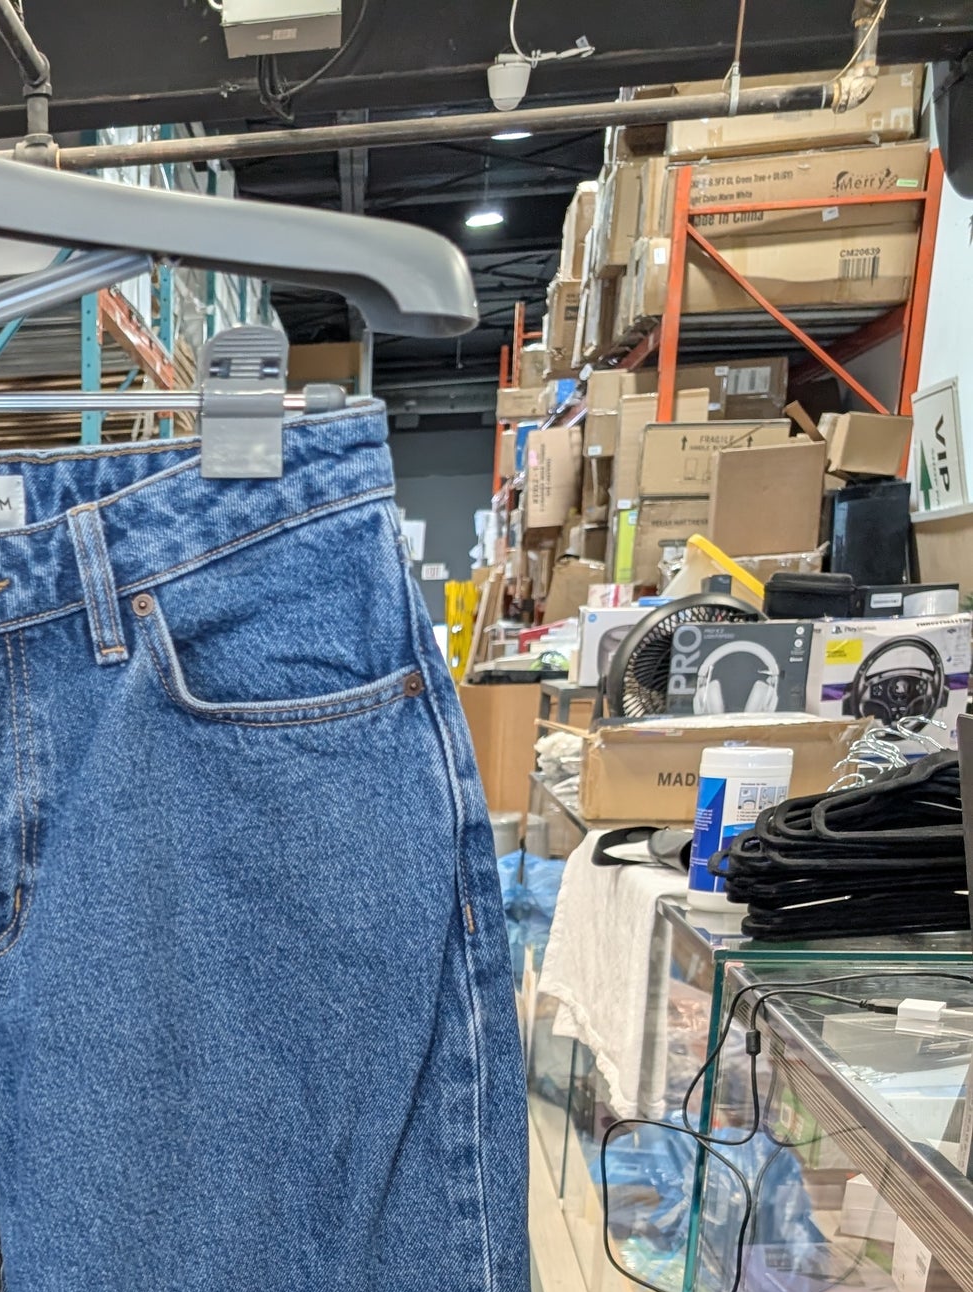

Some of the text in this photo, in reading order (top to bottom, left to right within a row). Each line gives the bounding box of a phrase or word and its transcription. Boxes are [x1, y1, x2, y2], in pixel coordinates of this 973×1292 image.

[754, 173, 766, 182] Tree
[839, 176, 885, 190] Merry
[935, 414, 950, 492] VIP
[668, 625, 702, 695] PRO
[657, 772, 699, 787] MAD
